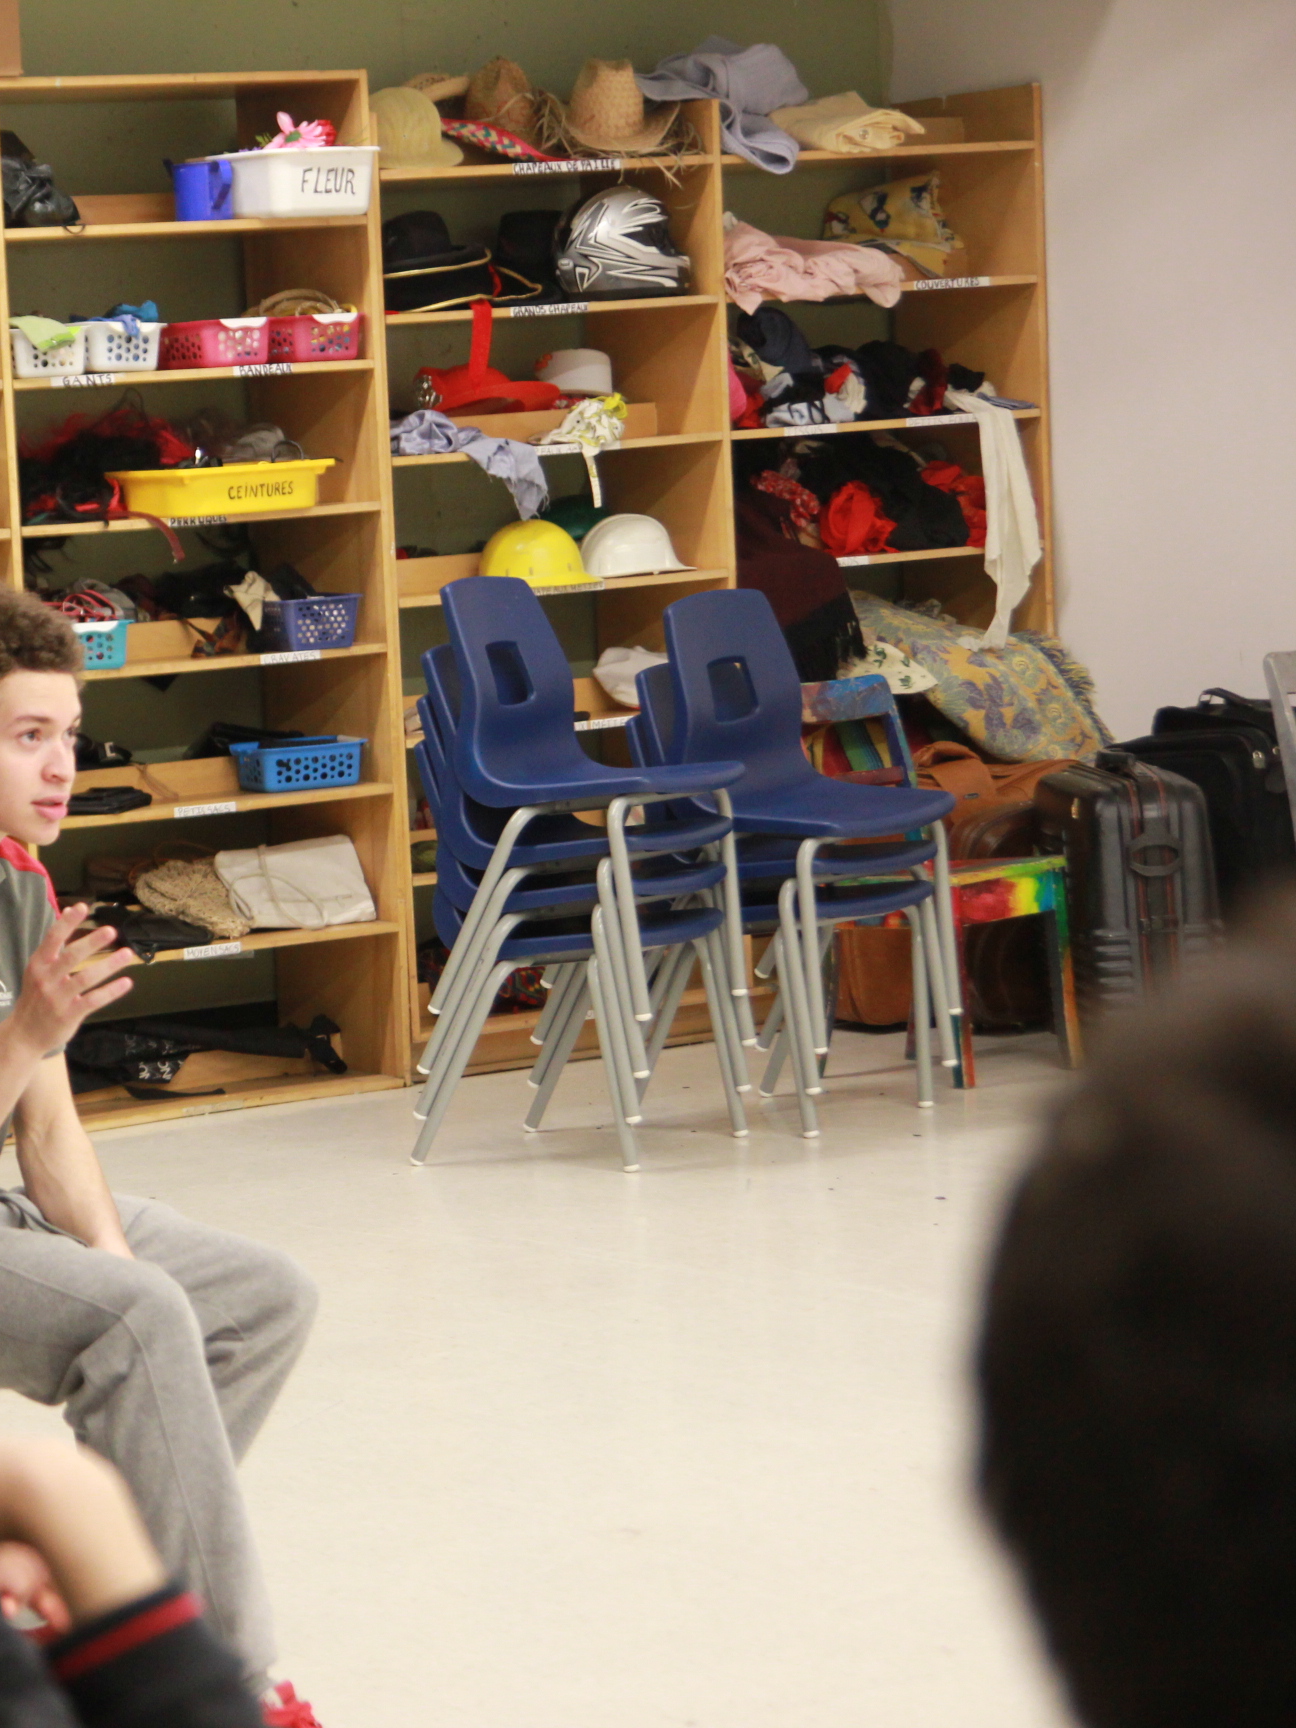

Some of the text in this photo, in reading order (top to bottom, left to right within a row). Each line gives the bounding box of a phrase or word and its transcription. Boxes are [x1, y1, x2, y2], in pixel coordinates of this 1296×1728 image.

[301, 167, 355, 195] FLEUR
[915, 277, 980, 290] COUVERTURES
[62, 374, 113, 388] GANTS
[228, 480, 295, 500] CEINTURES
